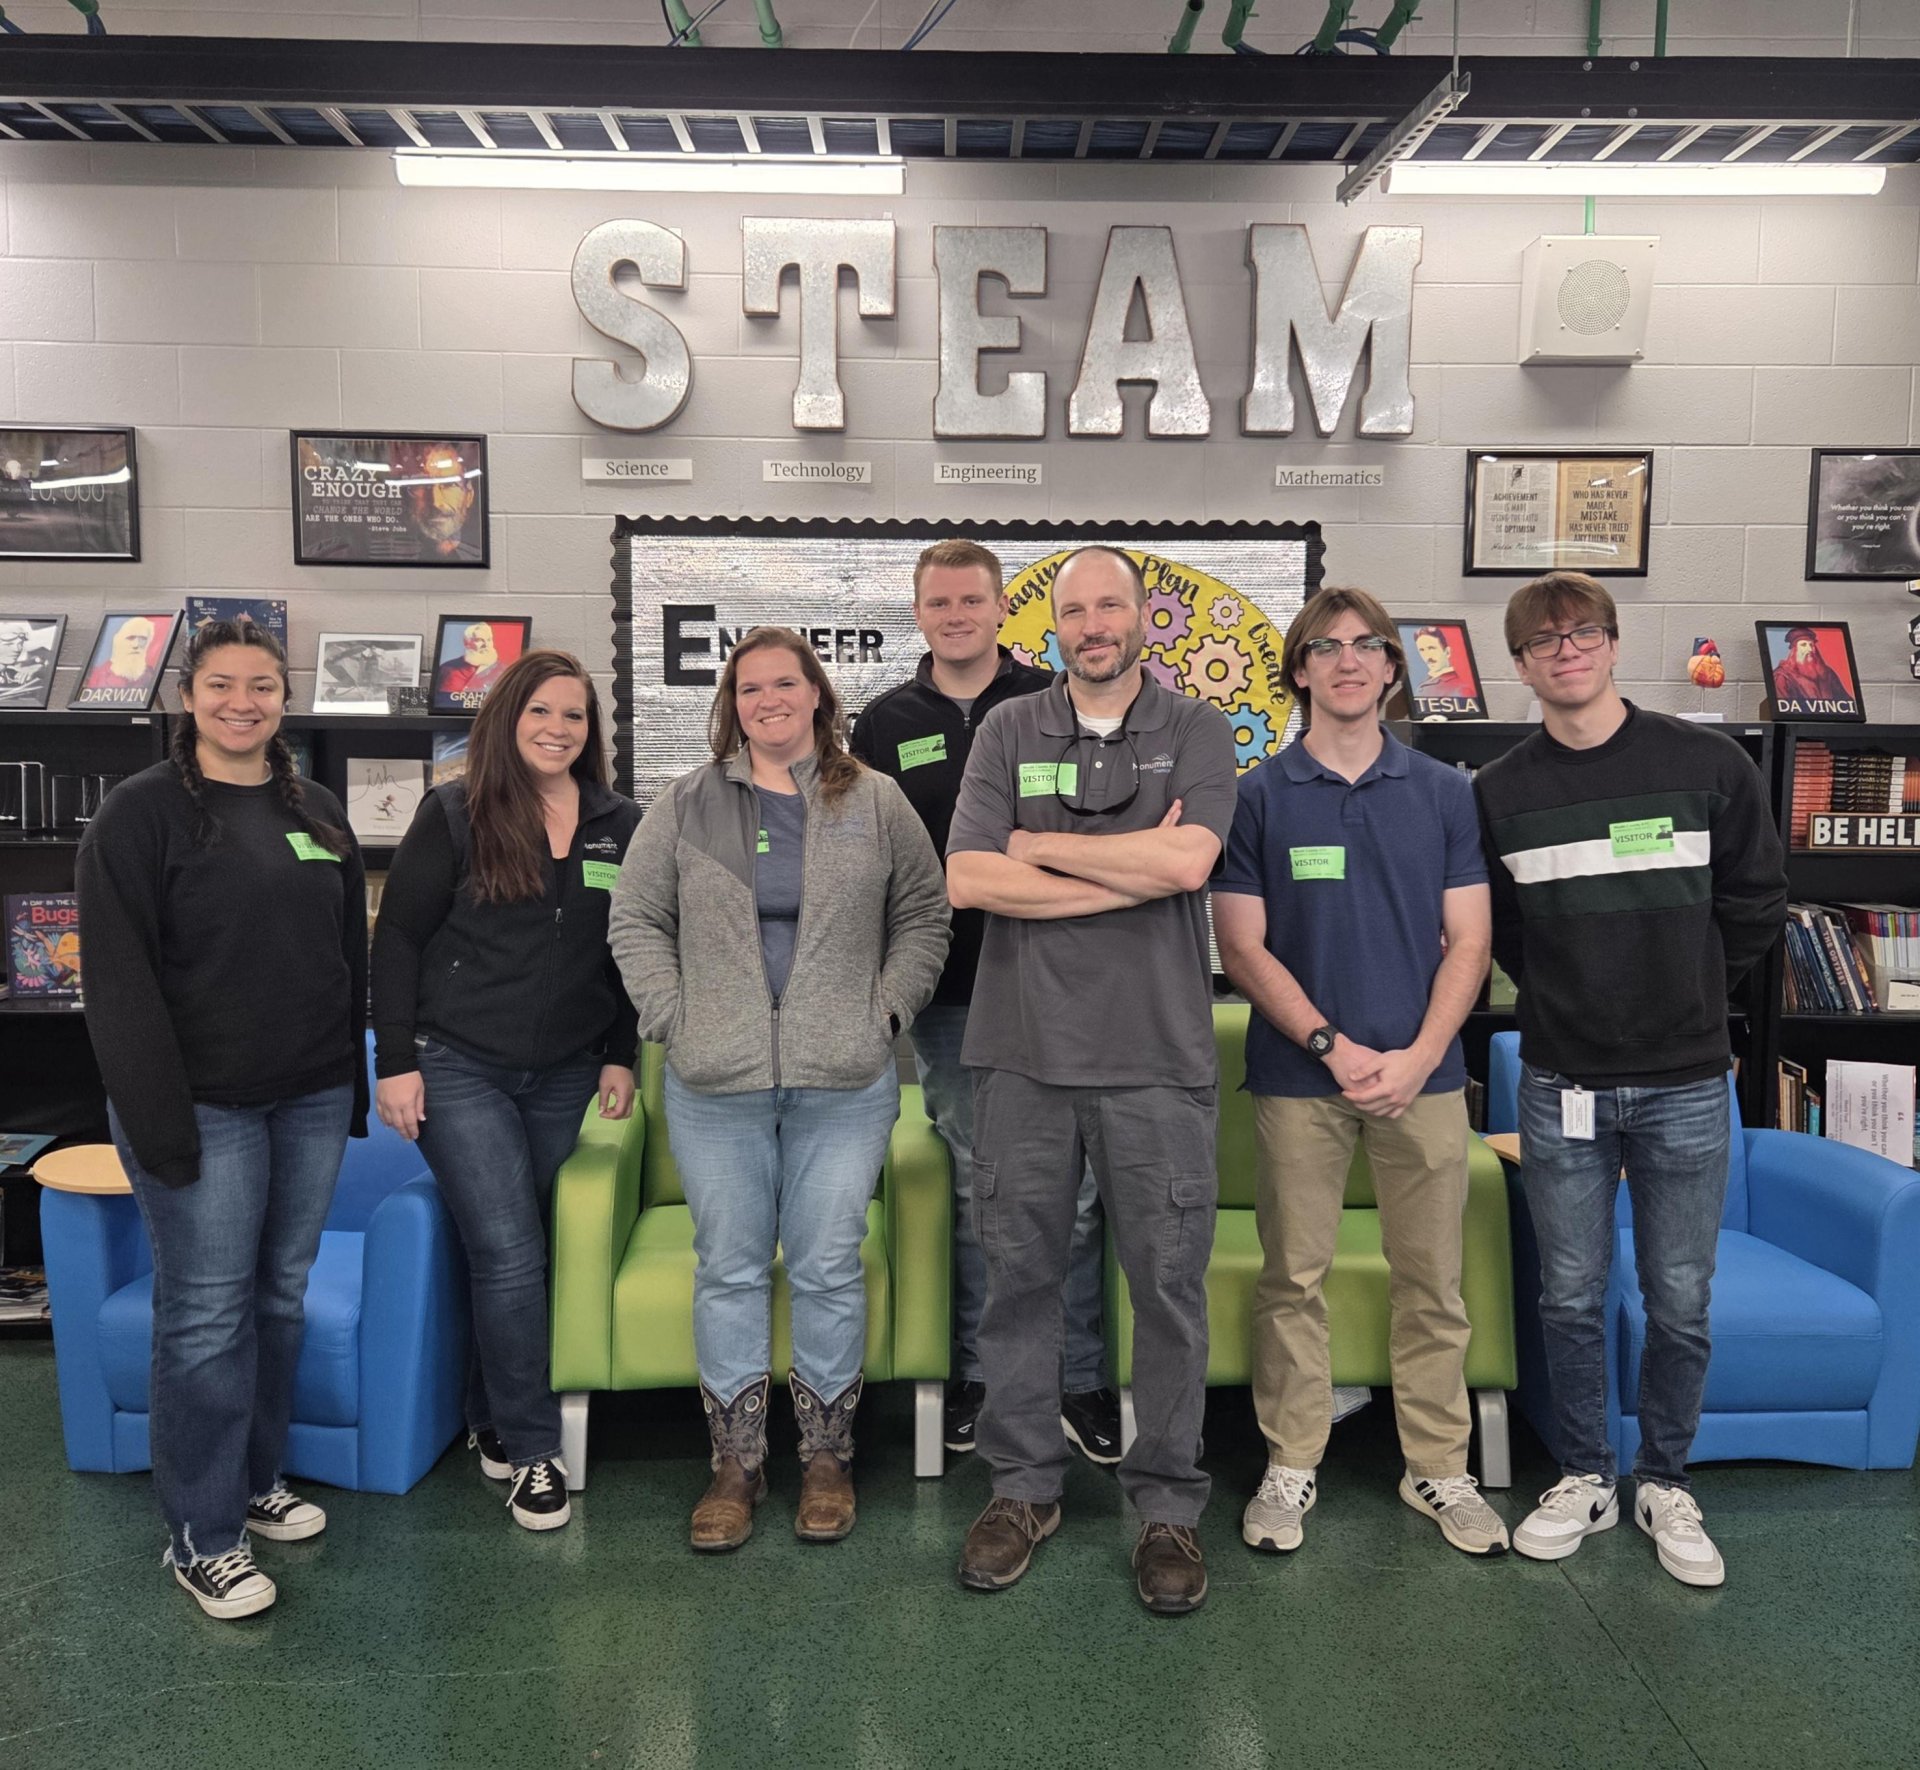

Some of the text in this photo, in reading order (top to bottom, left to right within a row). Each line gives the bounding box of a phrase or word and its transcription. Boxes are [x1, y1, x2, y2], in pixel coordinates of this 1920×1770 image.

[572, 217, 1424, 437] STEAM
[304, 466, 377, 481] CRAZY
[604, 460, 670, 477] Science
[770, 461, 865, 482] Technology
[940, 463, 1037, 484] Engineering
[1279, 469, 1381, 485] Mathematics
[311, 482, 403, 498] ENOUGH
[1573, 490, 1628, 499] WHO HAS NEVER
[1493, 493, 1538, 501] ACHIEVEMENT
[312, 505, 403, 516] CHANGE THE WORLD
[1586, 501, 1613, 510] MADE A
[305, 514, 320, 522] ARE
[342, 515, 363, 523] ONES
[366, 515, 382, 523] WHO
[1580, 511, 1618, 521] MISTAKE
[1504, 525, 1536, 533] OPTIMISM
[1569, 523, 1629, 532] HAS NEVER TRIED
[1851, 523, 1874, 531] you're
[1573, 534, 1627, 543] ANYTHING NEW
[1140, 554, 1199, 602] Plan
[79, 687, 148, 702] DARWIN
[1414, 697, 1480, 713] TESLA
[1777, 700, 1856, 713] DA VINCI
[901, 747, 930, 759] VISITOR
[366, 764, 397, 790] ish
[1615, 832, 1653, 843] VISITOR
[1813, 817, 1920, 846] BE HEL
[1294, 858, 1329, 867] VISITOR
[31, 906, 79, 925] Bugs
[1823, 931, 1833, 948] THE
[1829, 950, 1847, 986] ODYSSEY
[1871, 1080, 1878, 1088] or
[1881, 1074, 1889, 1100] Whether
[1870, 1088, 1878, 1100] you
[1880, 1101, 1888, 1113] you
[1870, 1118, 1878, 1130] you
[1881, 1114, 1889, 1131] think
[1880, 1131, 1888, 1143] you
